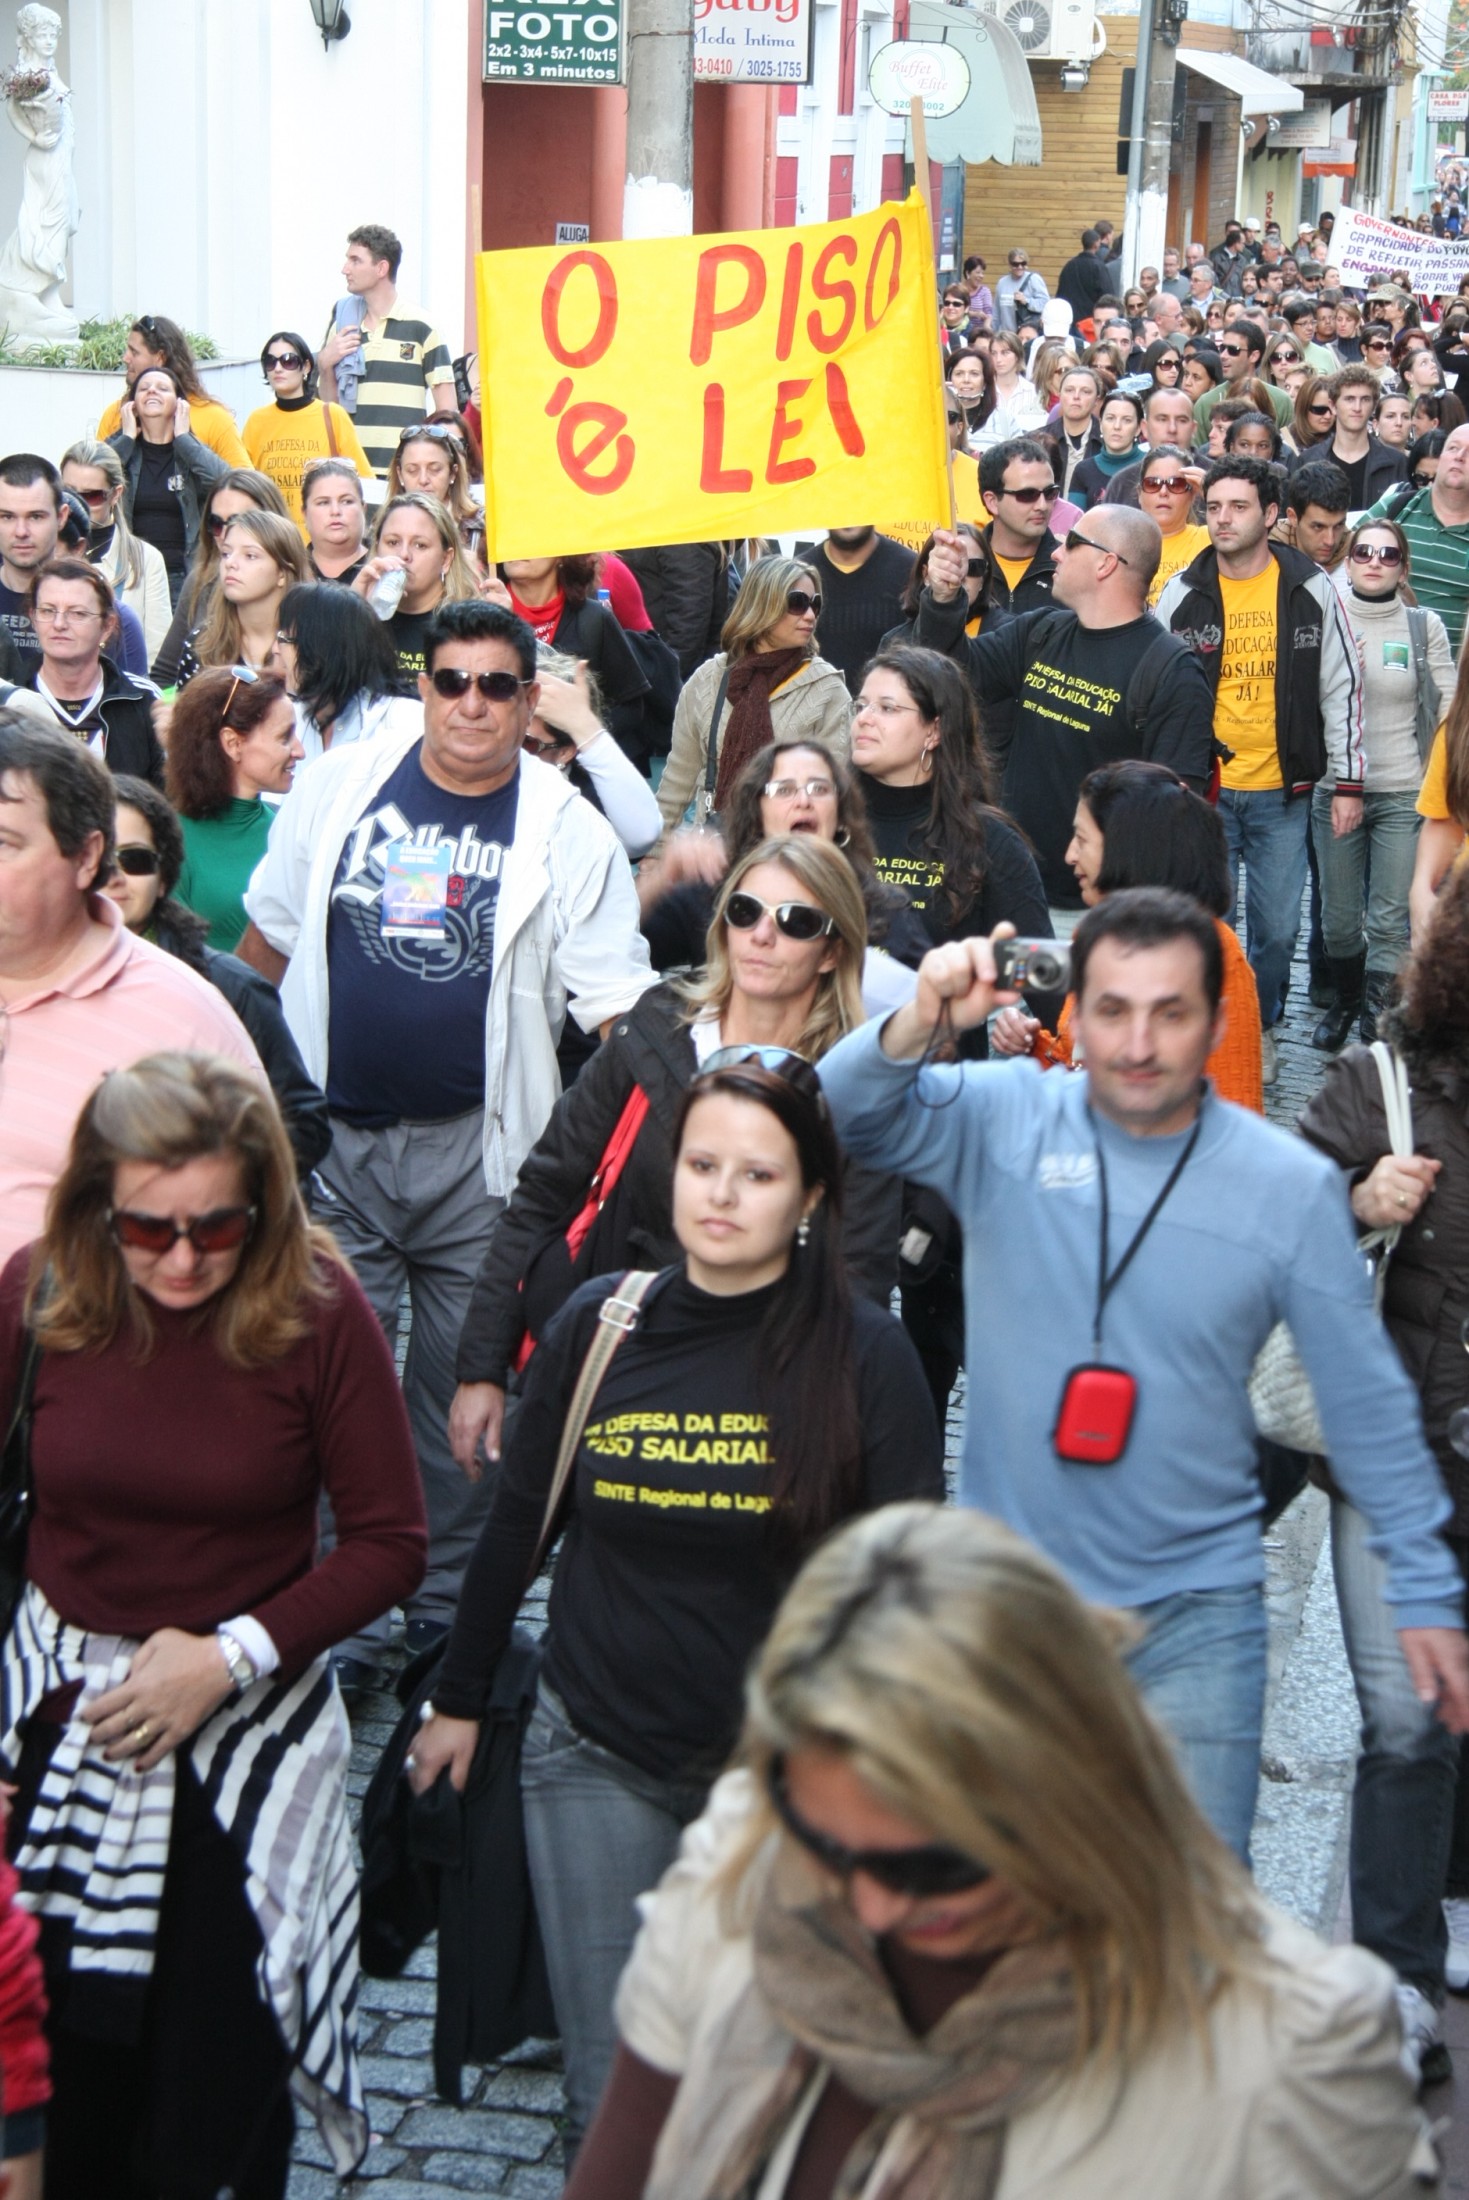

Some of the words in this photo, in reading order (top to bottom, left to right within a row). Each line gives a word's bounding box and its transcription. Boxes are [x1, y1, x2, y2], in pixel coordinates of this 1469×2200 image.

[490, 11, 618, 42] FOTO
[488, 43, 511, 57] 2x2
[519, 45, 543, 58] 3x4
[550, 46, 573, 60] 5x7
[580, 47, 617, 62] 10x15
[488, 62, 517, 75] Em
[523, 63, 534, 76] 3
[540, 65, 615, 79] minutos
[747, 60, 802, 77] 3025-1755
[1346, 245, 1365, 257] DE
[541, 250, 619, 369] O
[688, 216, 902, 366] PISO
[699, 362, 865, 493] LEI
[275, 438, 306, 452] DEFESA
[307, 439, 320, 452] DA
[1229, 611, 1274, 630] DEFESA
[605, 1413, 679, 1435] DEFESA
[684, 1414, 715, 1433] DA
[594, 1480, 636, 1501] SINTE
[639, 1487, 706, 1508] Regional
[710, 1491, 732, 1509] de
